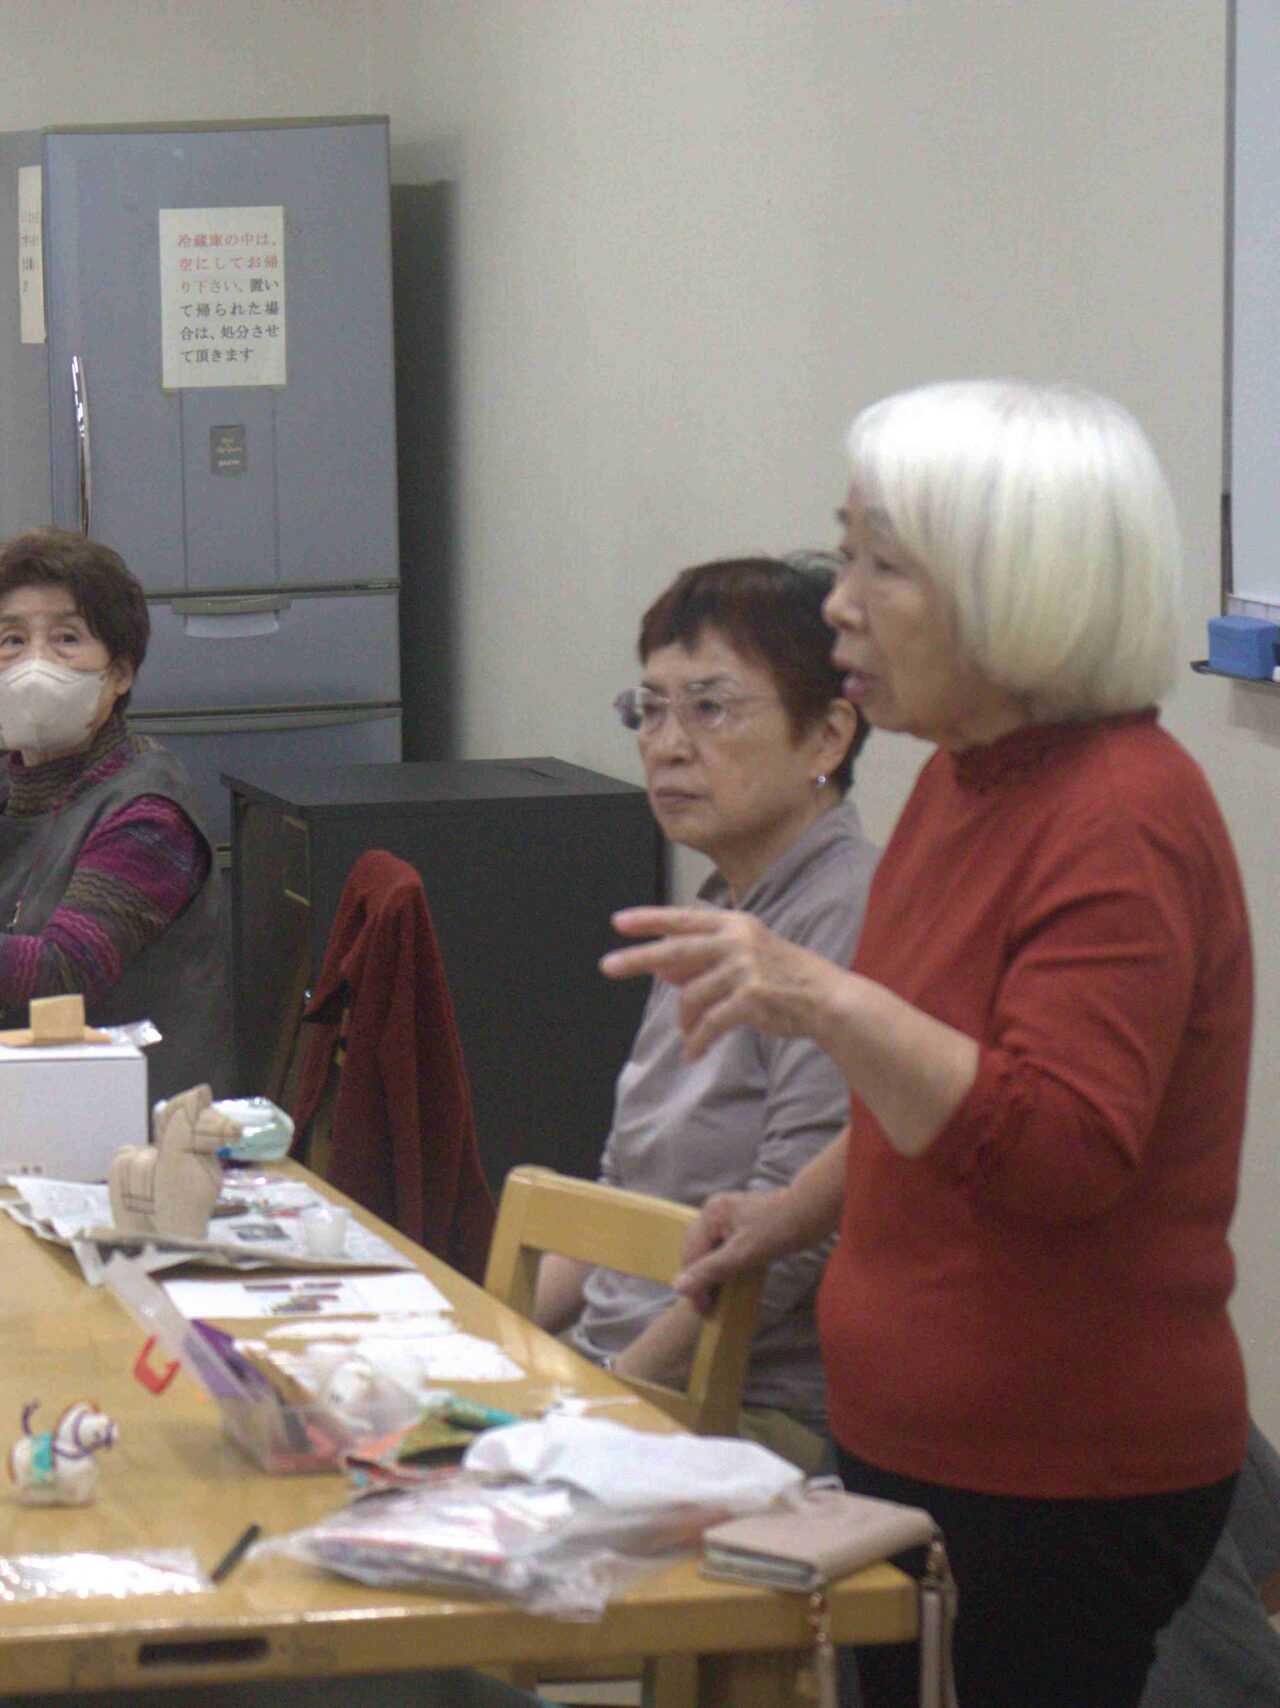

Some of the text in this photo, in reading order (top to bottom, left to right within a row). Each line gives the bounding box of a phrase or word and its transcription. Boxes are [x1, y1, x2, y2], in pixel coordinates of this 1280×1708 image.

[177, 232, 277, 249] 冷蔵庫の中は、
[179, 255, 279, 272] 空にしてお帰
[180, 278, 279, 294] り下さい。置い
[180, 301, 280, 318] て帰られた場
[180, 324, 280, 341] 合は、処分させ
[180, 347, 254, 364] て頂きます
